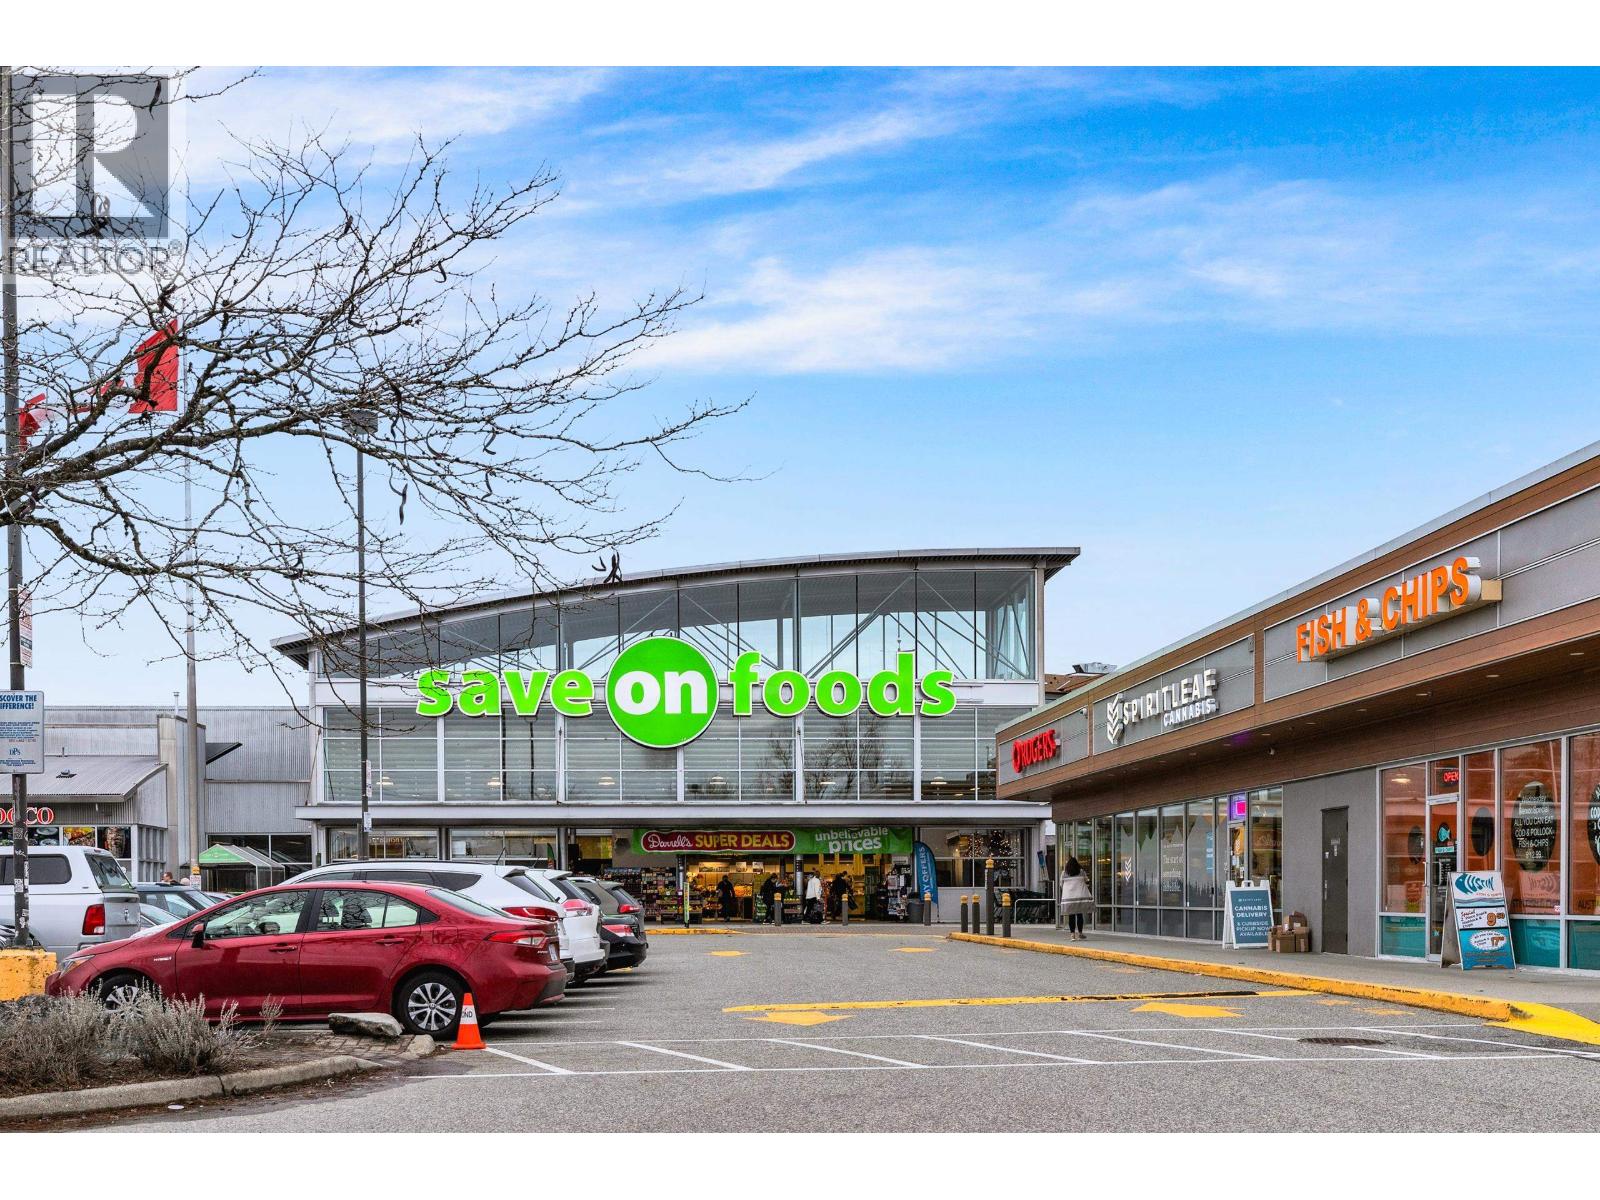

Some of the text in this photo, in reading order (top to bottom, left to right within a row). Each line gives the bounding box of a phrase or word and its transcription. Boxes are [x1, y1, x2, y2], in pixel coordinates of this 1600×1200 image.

[1296, 556, 1476, 663] FISH & CHIPS
[415, 649, 958, 718] save on foods
[25, 694, 37, 702] THE
[1123, 668, 1217, 725] SPIRITLEAF
[1163, 698, 1217, 728] CANNABIS
[1514, 816, 1554, 827] ALL YOU CAN EAT
[815, 826, 889, 842] unbelievable
[1515, 829, 1526, 838] COD
[1530, 827, 1553, 836] POLLOCK
[695, 834, 738, 848] SUPER
[741, 834, 790, 848] DEALS
[828, 837, 883, 853] prices
[1518, 840, 1530, 848] FISH
[1534, 838, 1549, 847] CHIPS
[919, 847, 929, 882] OFFERS
